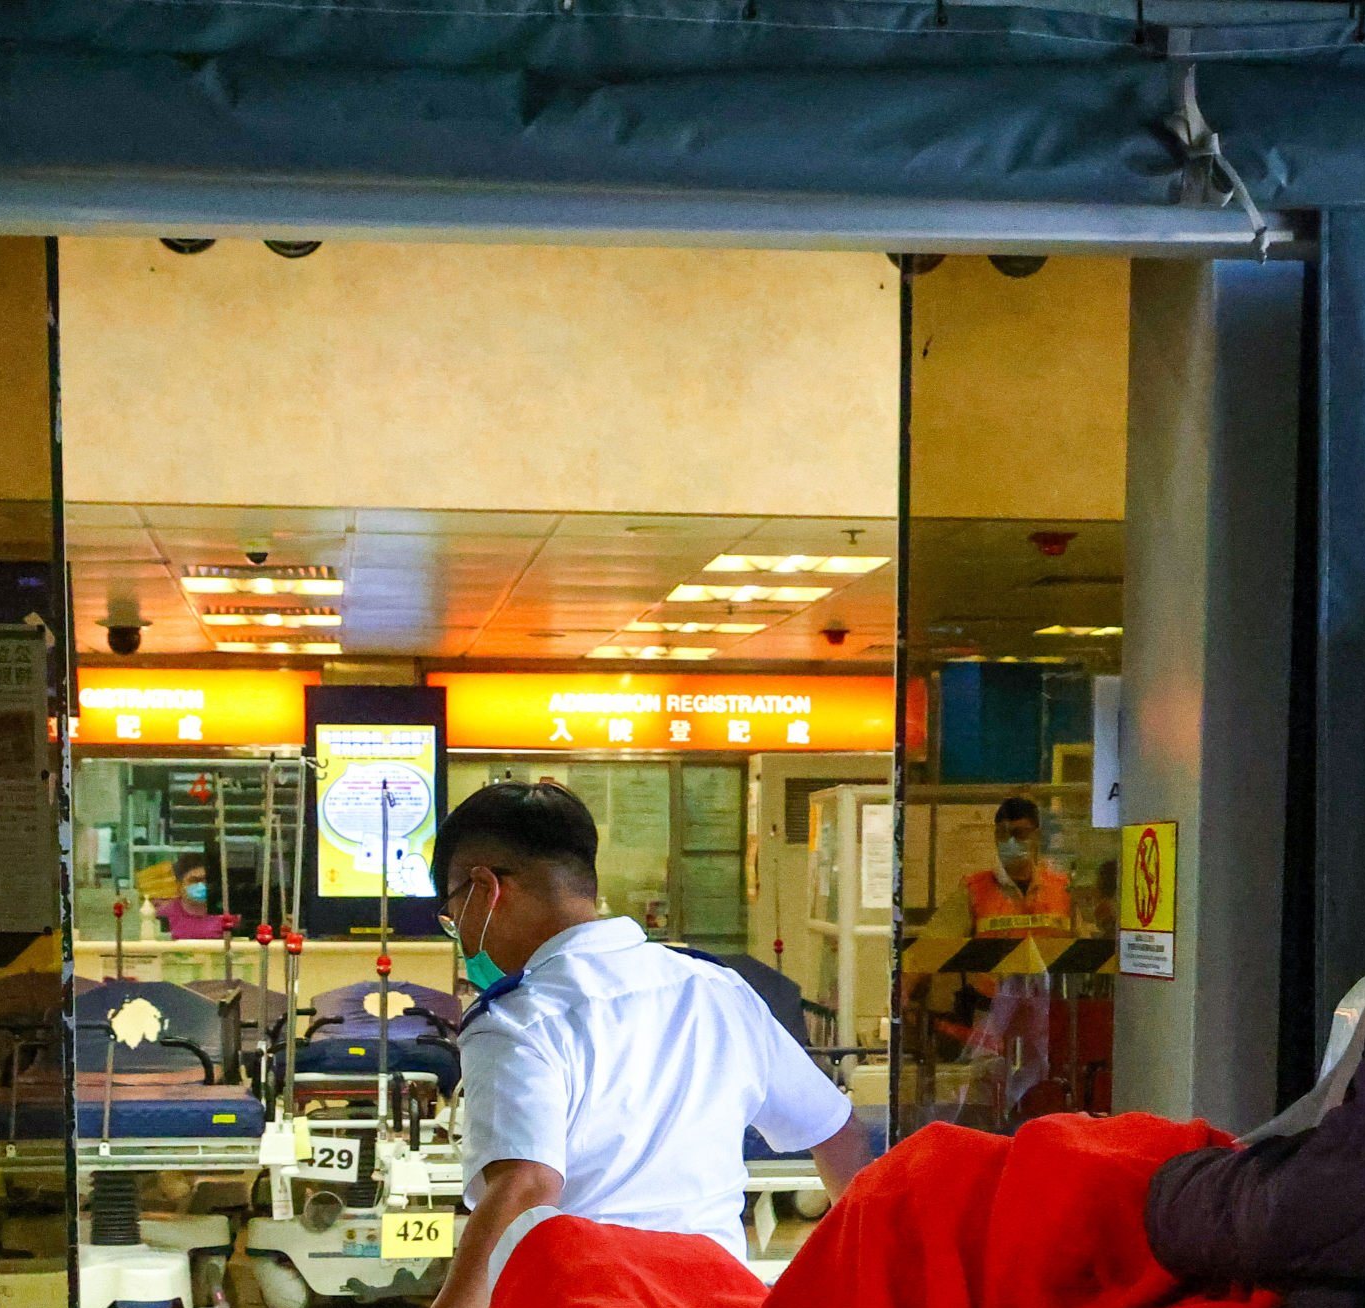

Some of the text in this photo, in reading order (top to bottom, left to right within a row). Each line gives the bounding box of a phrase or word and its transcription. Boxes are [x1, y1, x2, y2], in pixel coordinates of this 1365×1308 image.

[666, 694, 811, 714] REGISTRATION
[549, 718, 811, 744] 入院登記處
[396, 1220, 440, 1242] 426
